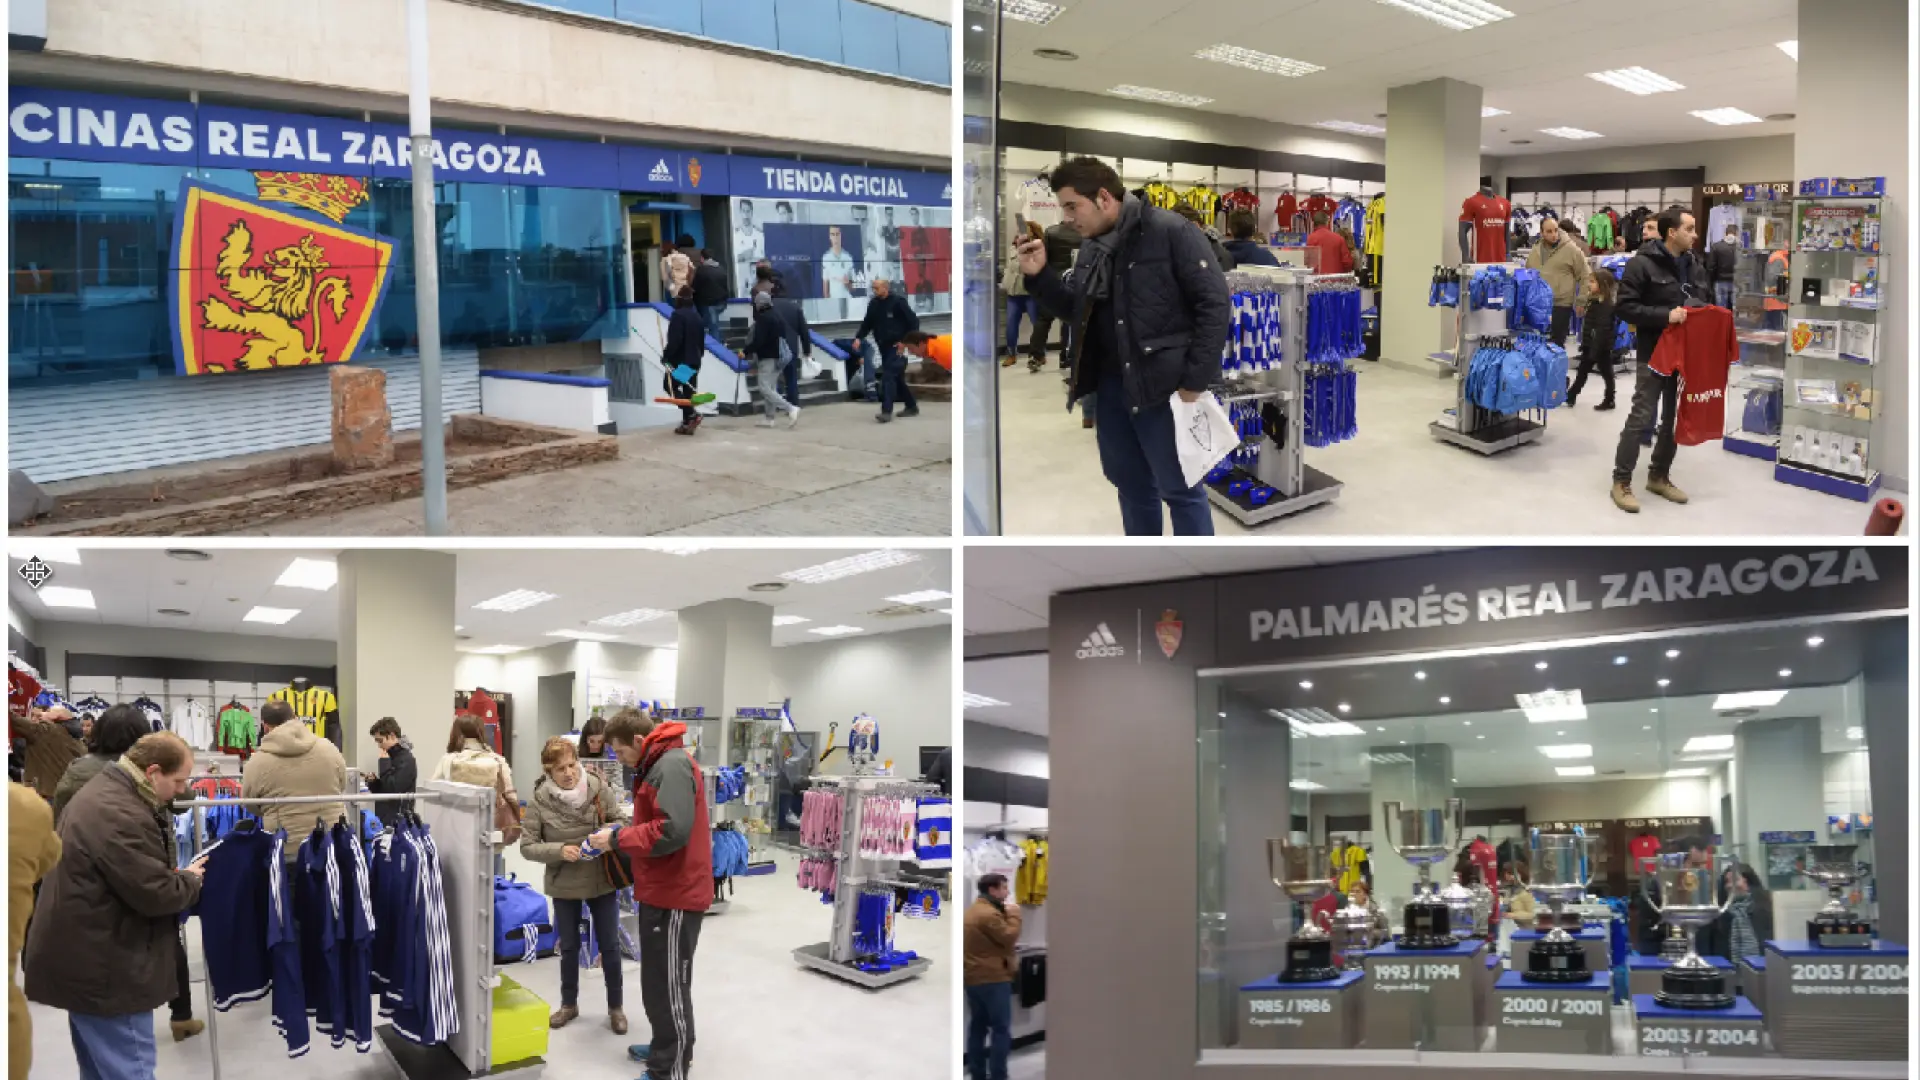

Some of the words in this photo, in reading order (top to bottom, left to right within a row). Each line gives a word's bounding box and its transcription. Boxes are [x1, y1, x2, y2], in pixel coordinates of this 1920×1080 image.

[10, 102, 194, 152] CINAS
[208, 120, 332, 163] REAL
[762, 167, 836, 194] TIENDA
[840, 174, 909, 198] OFICIAL
[1250, 584, 1470, 642] PALMARÉS
[1477, 579, 1593, 622] REAL
[1600, 547, 1879, 609] ZARAGOZA
[1373, 964, 1409, 980] 1993
[1423, 964, 1460, 980] 1994
[1791, 964, 1844, 981] 2003
[1249, 999, 1283, 1013] 1985
[1297, 999, 1331, 1013] 1986
[1502, 997, 1548, 1013] 2000
[1561, 1000, 1603, 1015] 2001
[1642, 1026, 1691, 1043] 2003
[1706, 1029, 1759, 1045] 2004
